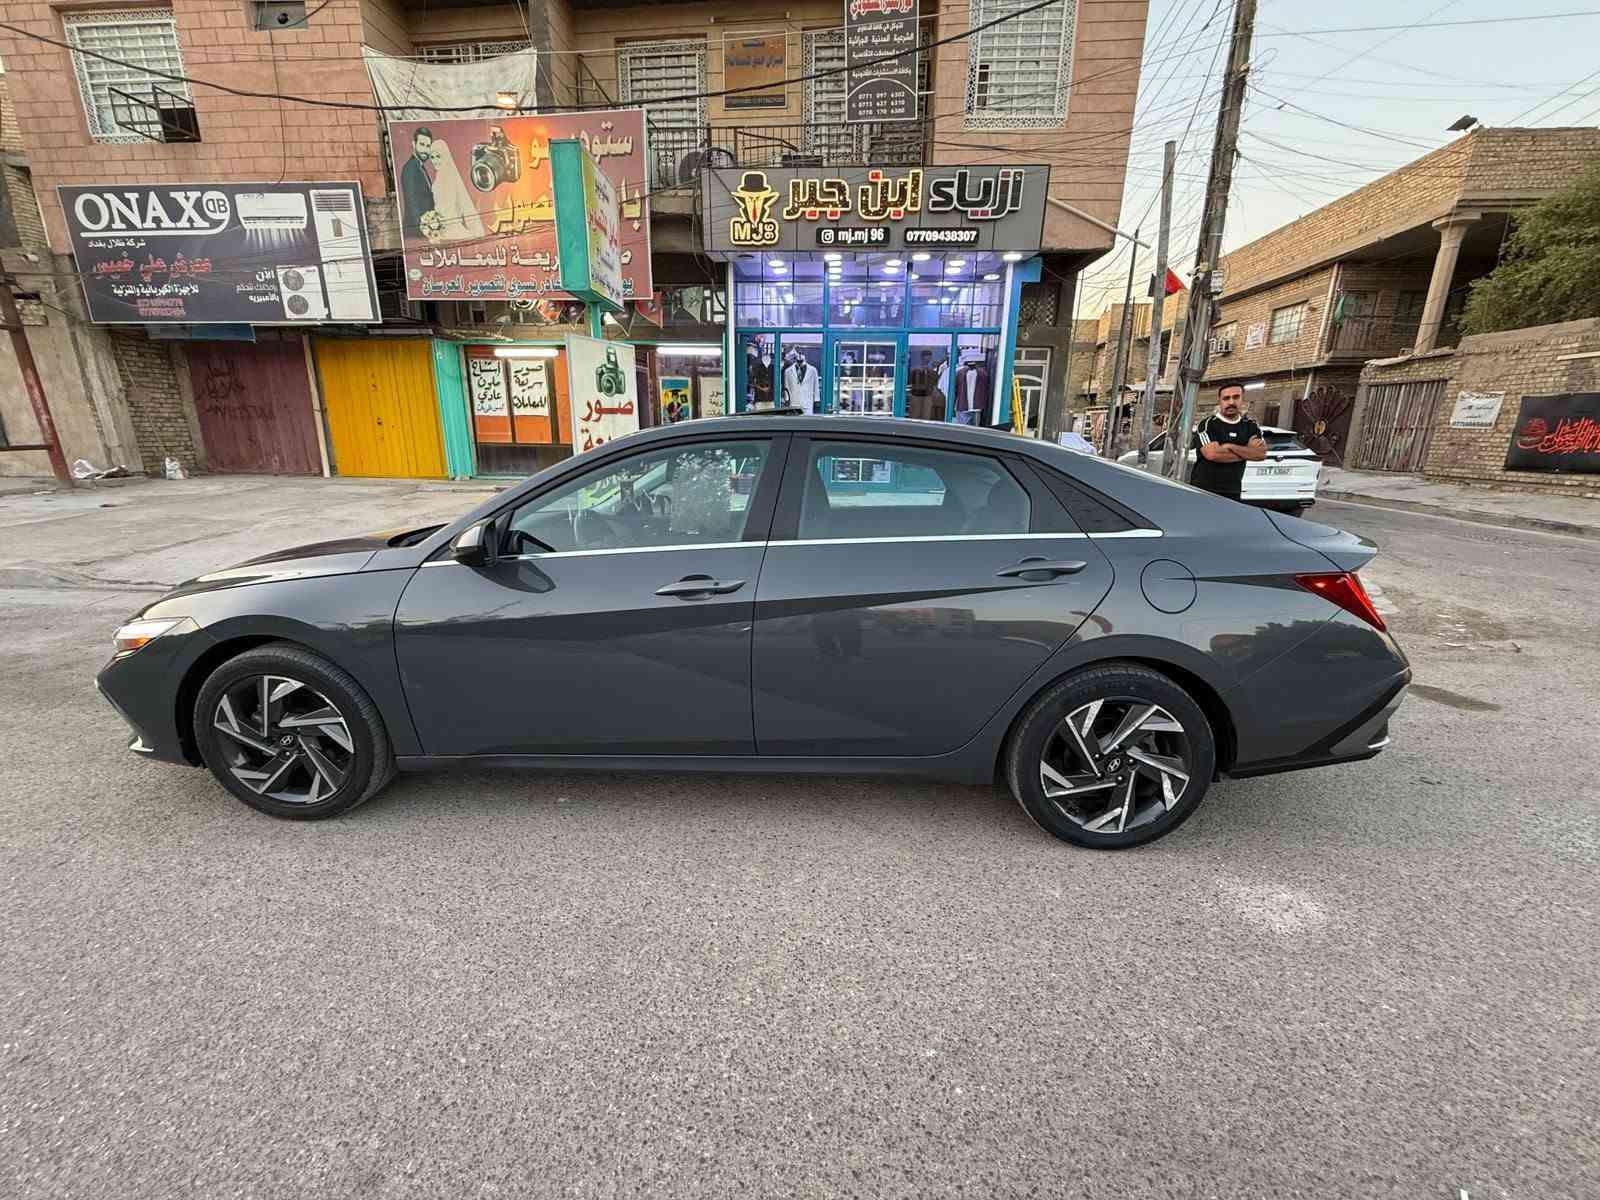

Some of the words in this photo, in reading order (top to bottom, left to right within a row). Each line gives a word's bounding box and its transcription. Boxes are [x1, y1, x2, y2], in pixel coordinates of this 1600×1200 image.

[75, 191, 210, 231] ONAX
[838, 229, 867, 244] mj.mj
[870, 228, 884, 240] 96
[906, 230, 977, 242] 07709438307
[511, 245, 561, 271] ريعة
[580, 399, 634, 422] صور
